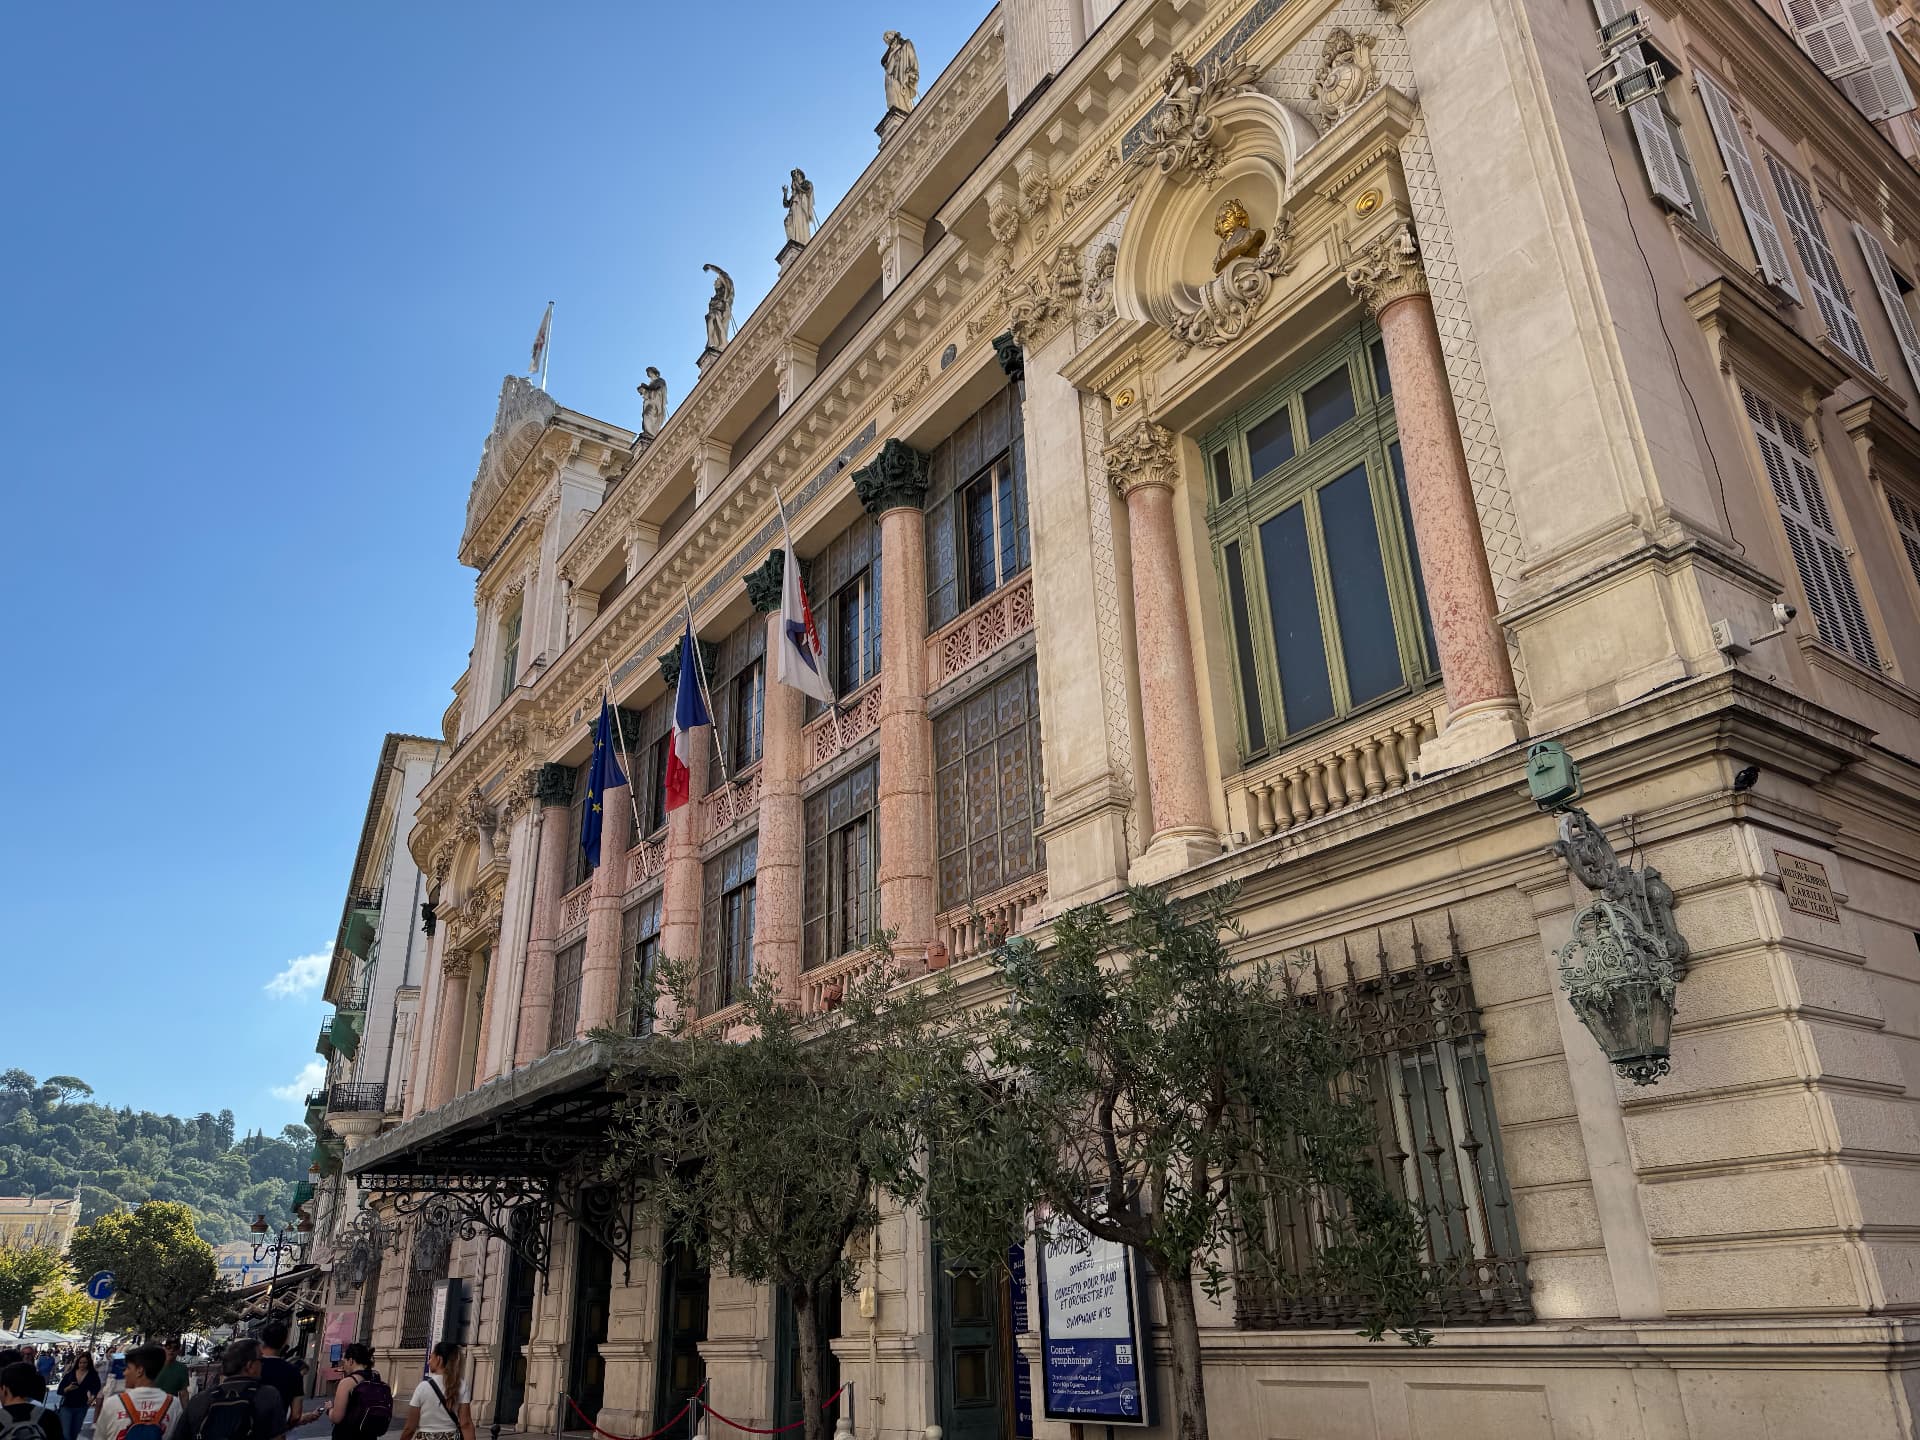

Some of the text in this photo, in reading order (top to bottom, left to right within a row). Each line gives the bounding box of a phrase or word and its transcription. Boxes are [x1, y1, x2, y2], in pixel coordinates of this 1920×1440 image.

[1794, 861, 1809, 871] RUE
[1055, 1270, 1117, 1301] CONCERTO POUR PIANO
[1060, 1298, 1067, 1310] ET
[1068, 1287, 1103, 1309] ORCHESTRE
[1050, 1345, 1076, 1355] Concert
[1051, 1355, 1093, 1367] symphonique
